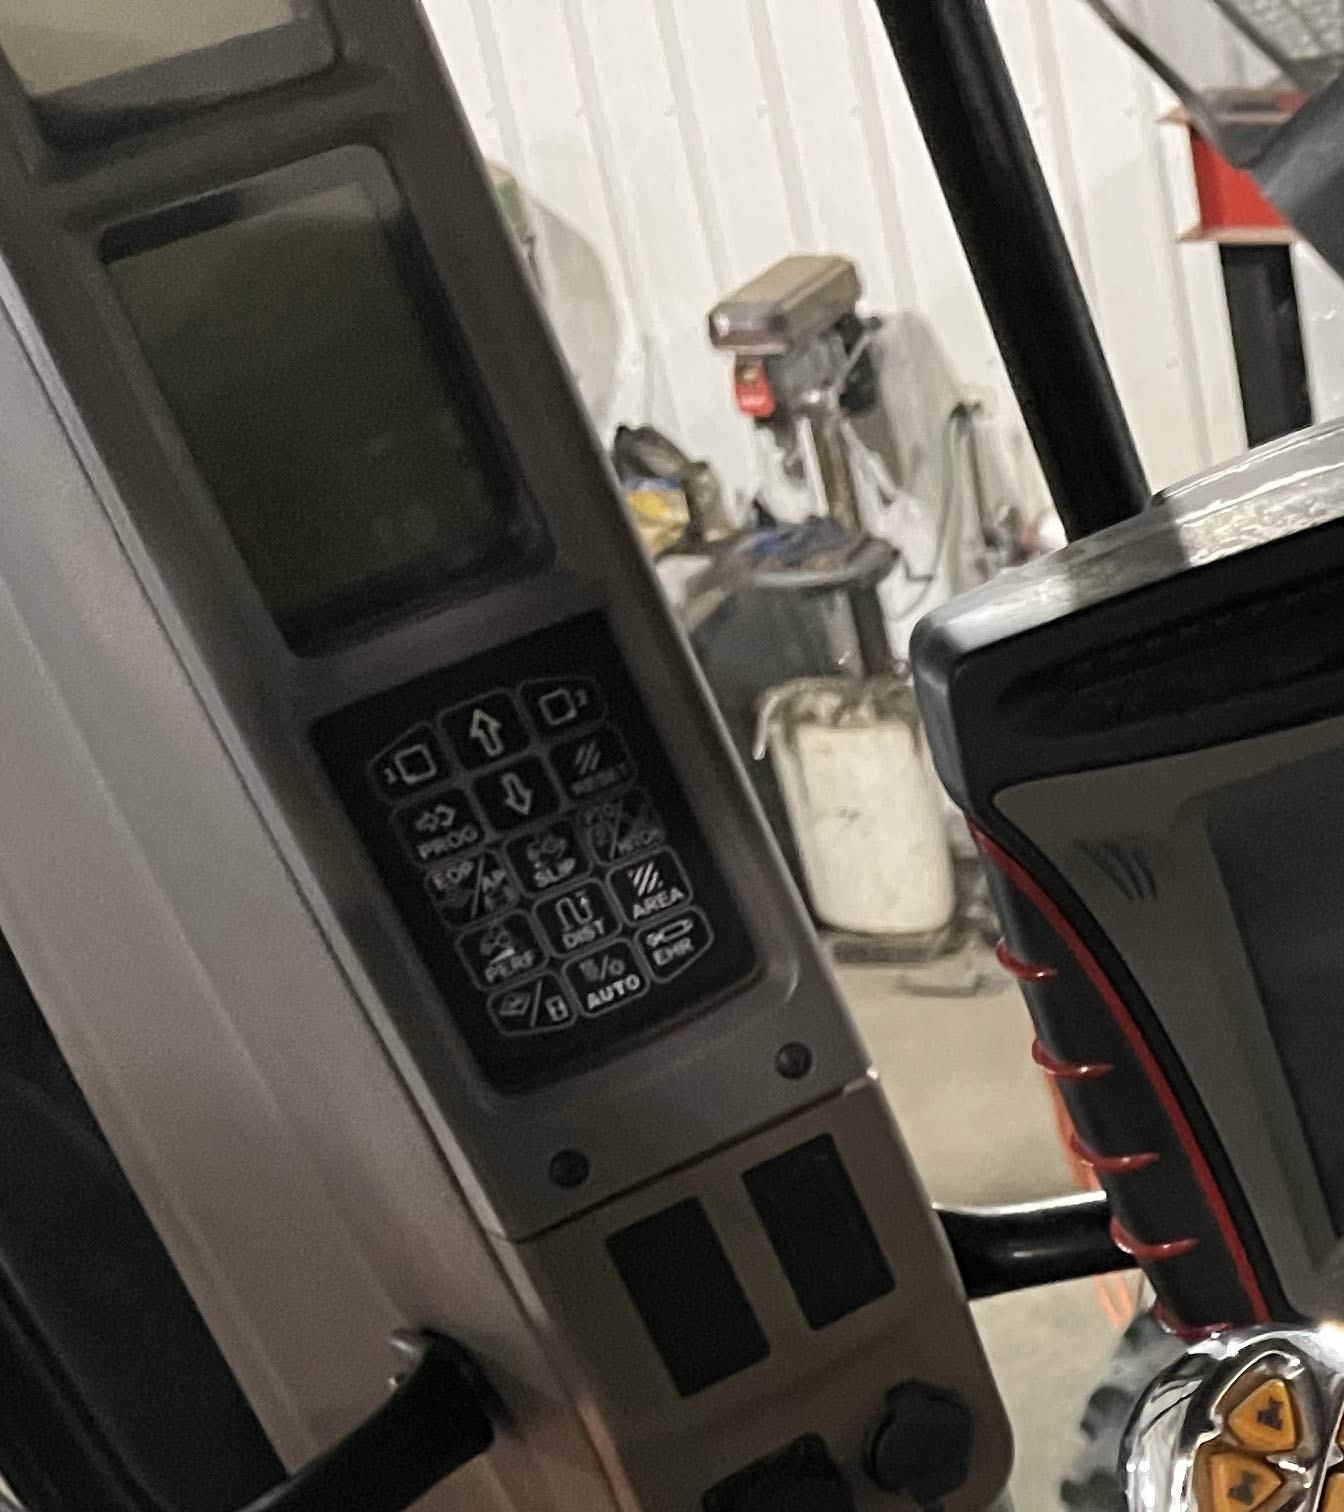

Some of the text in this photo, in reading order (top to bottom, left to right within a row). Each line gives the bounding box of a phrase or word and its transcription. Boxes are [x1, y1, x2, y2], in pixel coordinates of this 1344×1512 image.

[416, 826, 480, 861] PROG
[633, 886, 685, 919] AREA
[562, 919, 606, 949] DIST
[484, 949, 536, 983] PERF
[586, 973, 641, 1010] AUTO
